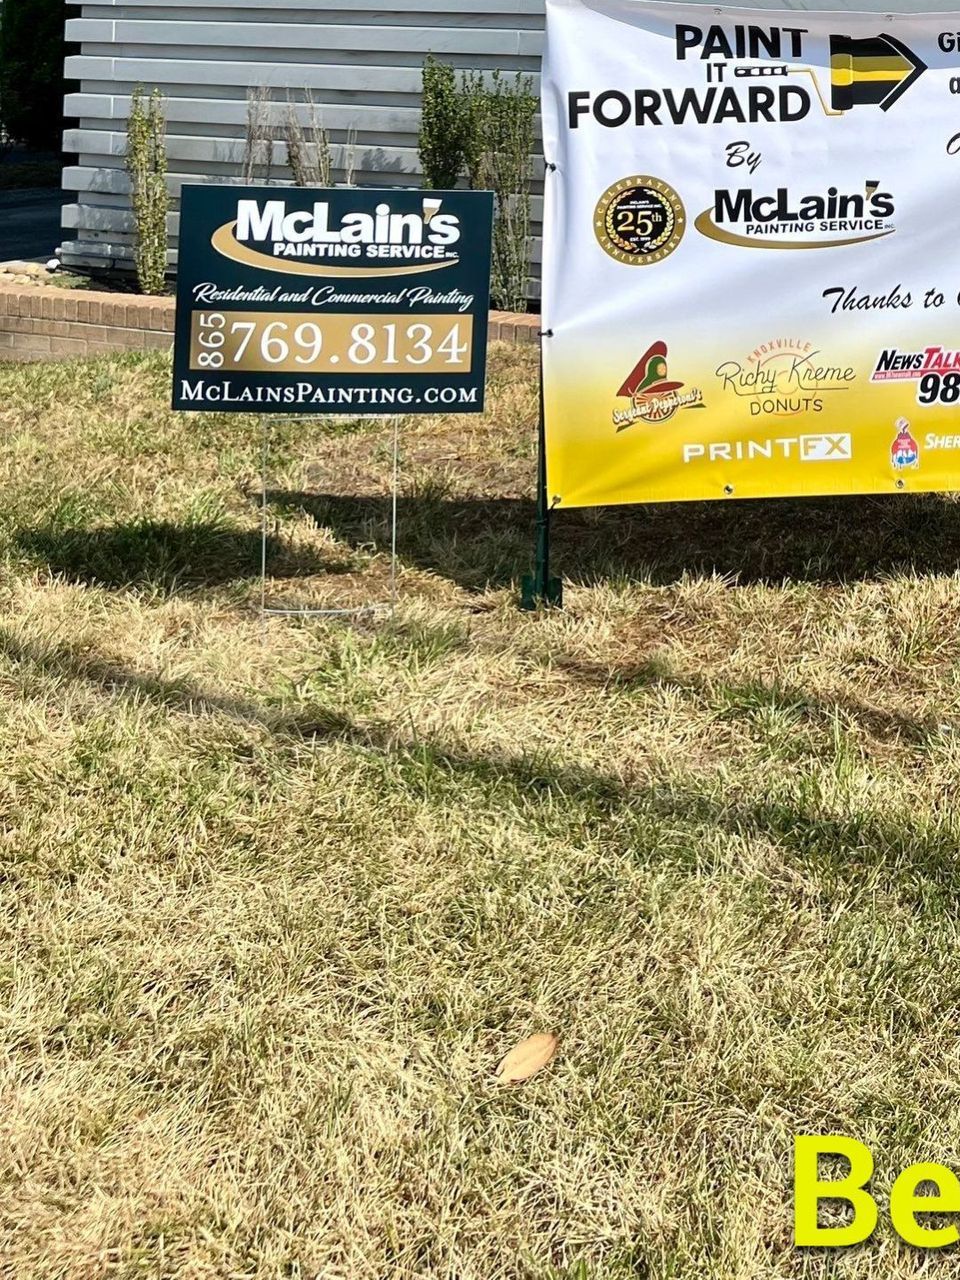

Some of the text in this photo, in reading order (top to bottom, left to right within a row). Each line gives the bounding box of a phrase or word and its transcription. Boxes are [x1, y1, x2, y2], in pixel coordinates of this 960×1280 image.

[675, 24, 808, 60] PAINT
[706, 62, 728, 82] IT
[568, 84, 811, 128] FORWARD
[725, 141, 762, 174] By
[597, 177, 681, 213] CELEBRATING
[714, 180, 895, 223] McLain's
[236, 198, 461, 245] McLain's
[617, 210, 662, 236] 25th
[746, 222, 815, 235] PAINTING
[819, 220, 883, 233] SERVICE
[273, 243, 361, 258] PAINTING
[366, 244, 445, 259] SERVICE
[192, 282, 475, 312] Residential and Commercial Painting
[822, 285, 914, 314] Thanks
[923, 289, 946, 307] to
[197, 313, 226, 368] 865
[229, 322, 468, 364] 769.8134
[747, 338, 812, 363] KNOXVILLE
[715, 350, 856, 396] Richy Kreme
[750, 399, 823, 415] DONUTS
